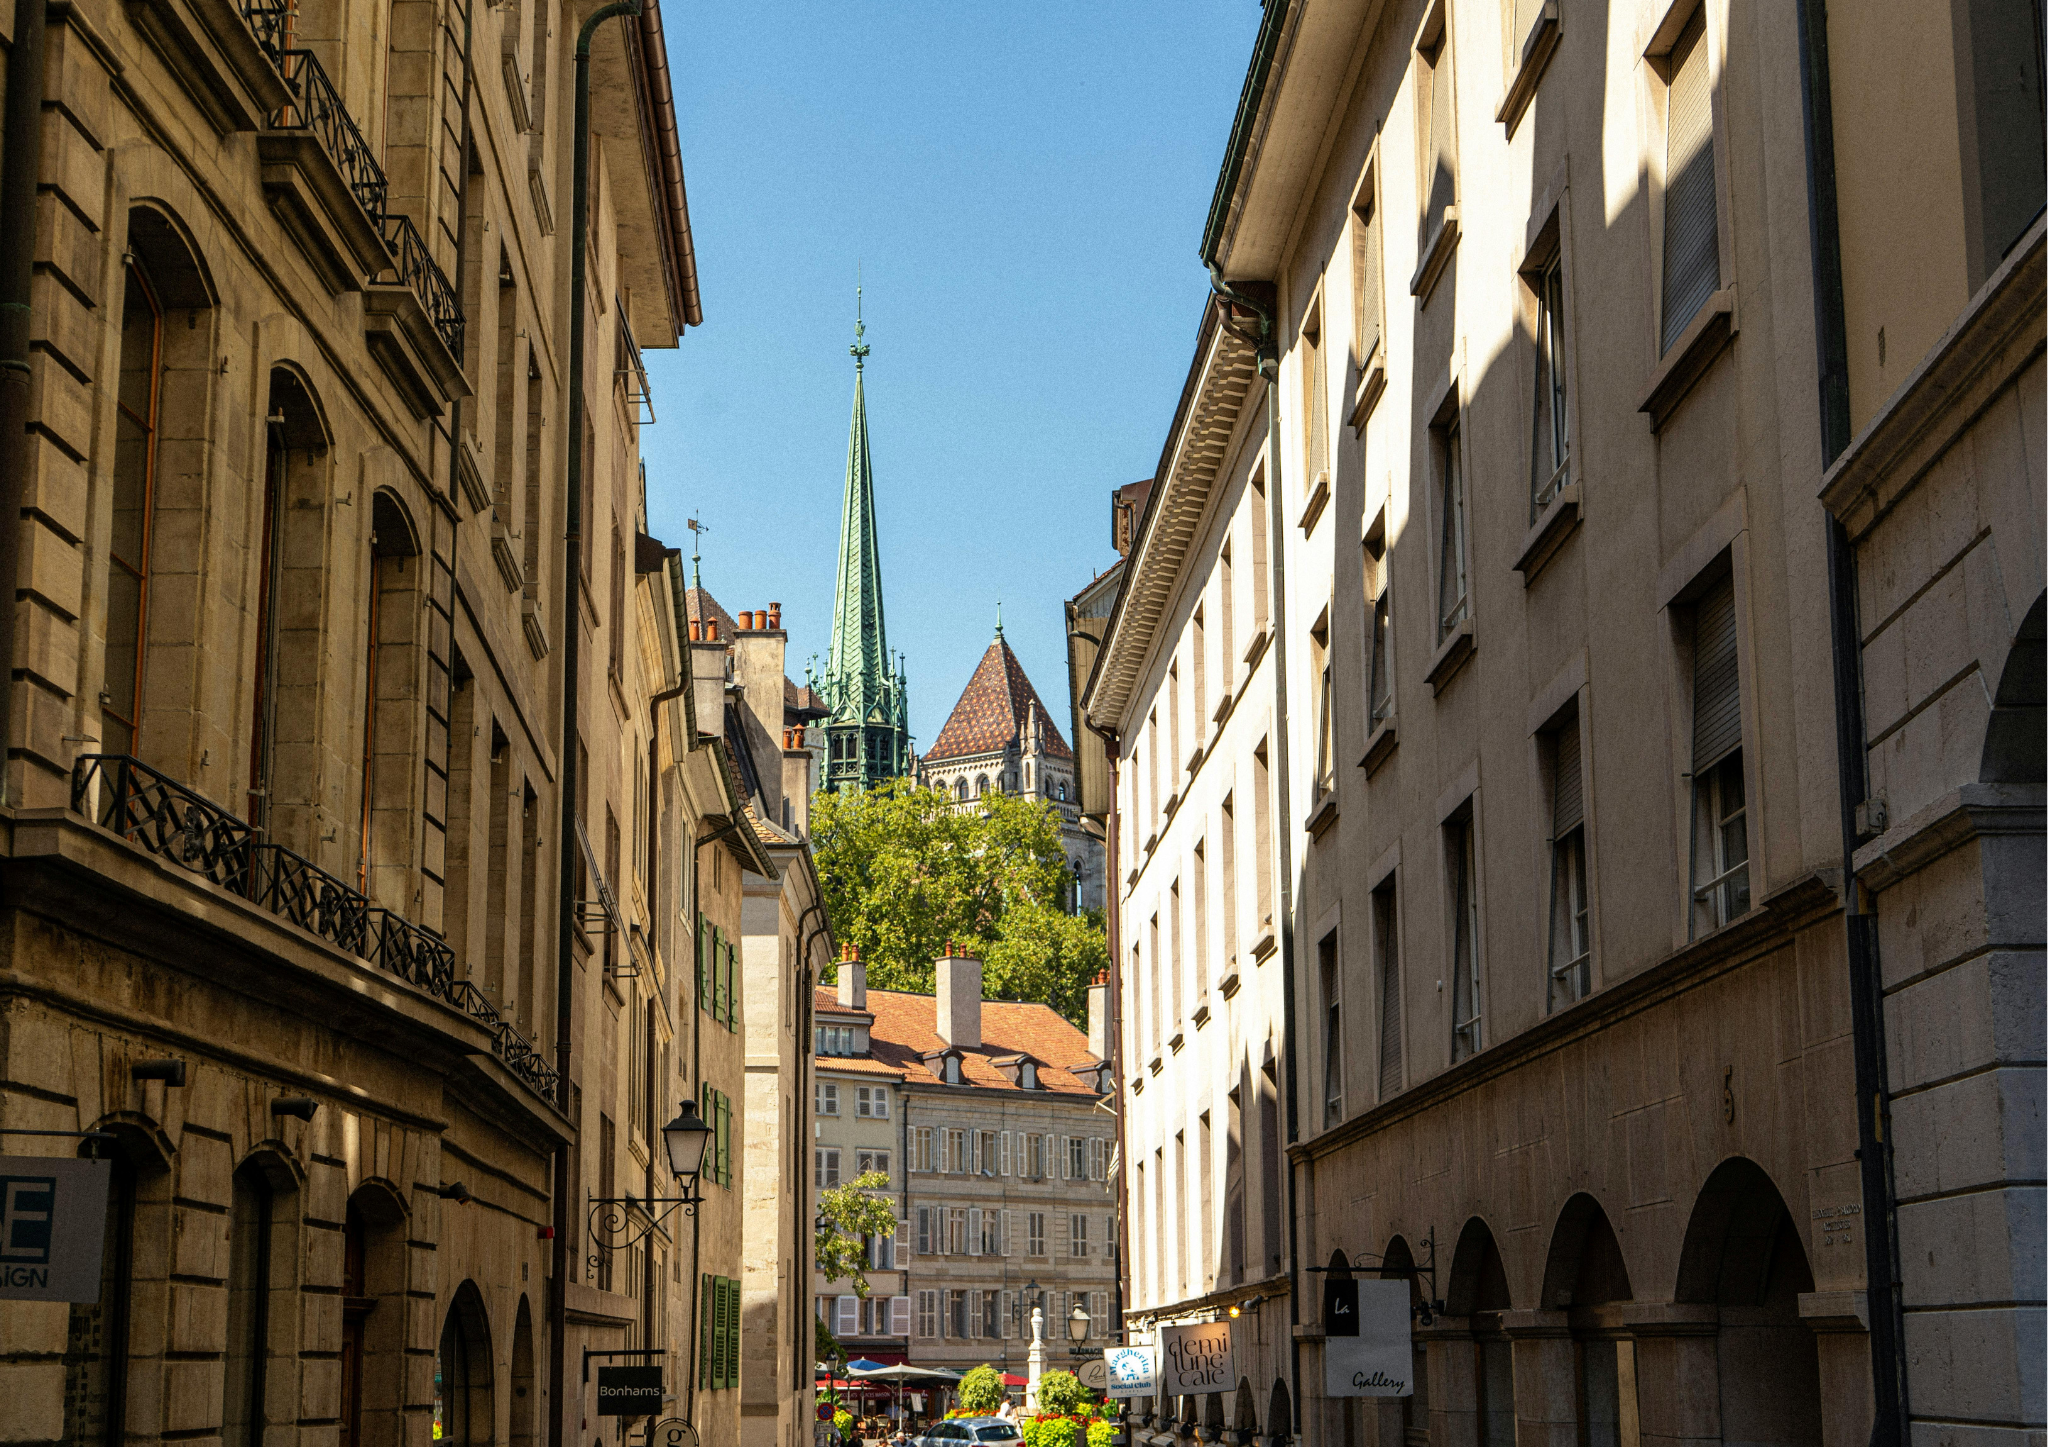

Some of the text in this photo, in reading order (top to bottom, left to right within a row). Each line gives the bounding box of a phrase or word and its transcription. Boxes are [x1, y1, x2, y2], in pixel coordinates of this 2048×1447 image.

[1723, 1064, 1735, 1124] 5
[0, 1181, 51, 1258] E
[1334, 1297, 1351, 1315] La
[1168, 1332, 1228, 1357] demi
[1109, 1348, 1150, 1376] Margherita
[1173, 1350, 1224, 1374] lune
[600, 1385, 660, 1397] Bonhams
[1110, 1382, 1134, 1390] Social
[1352, 1371, 1405, 1394] Gallery
